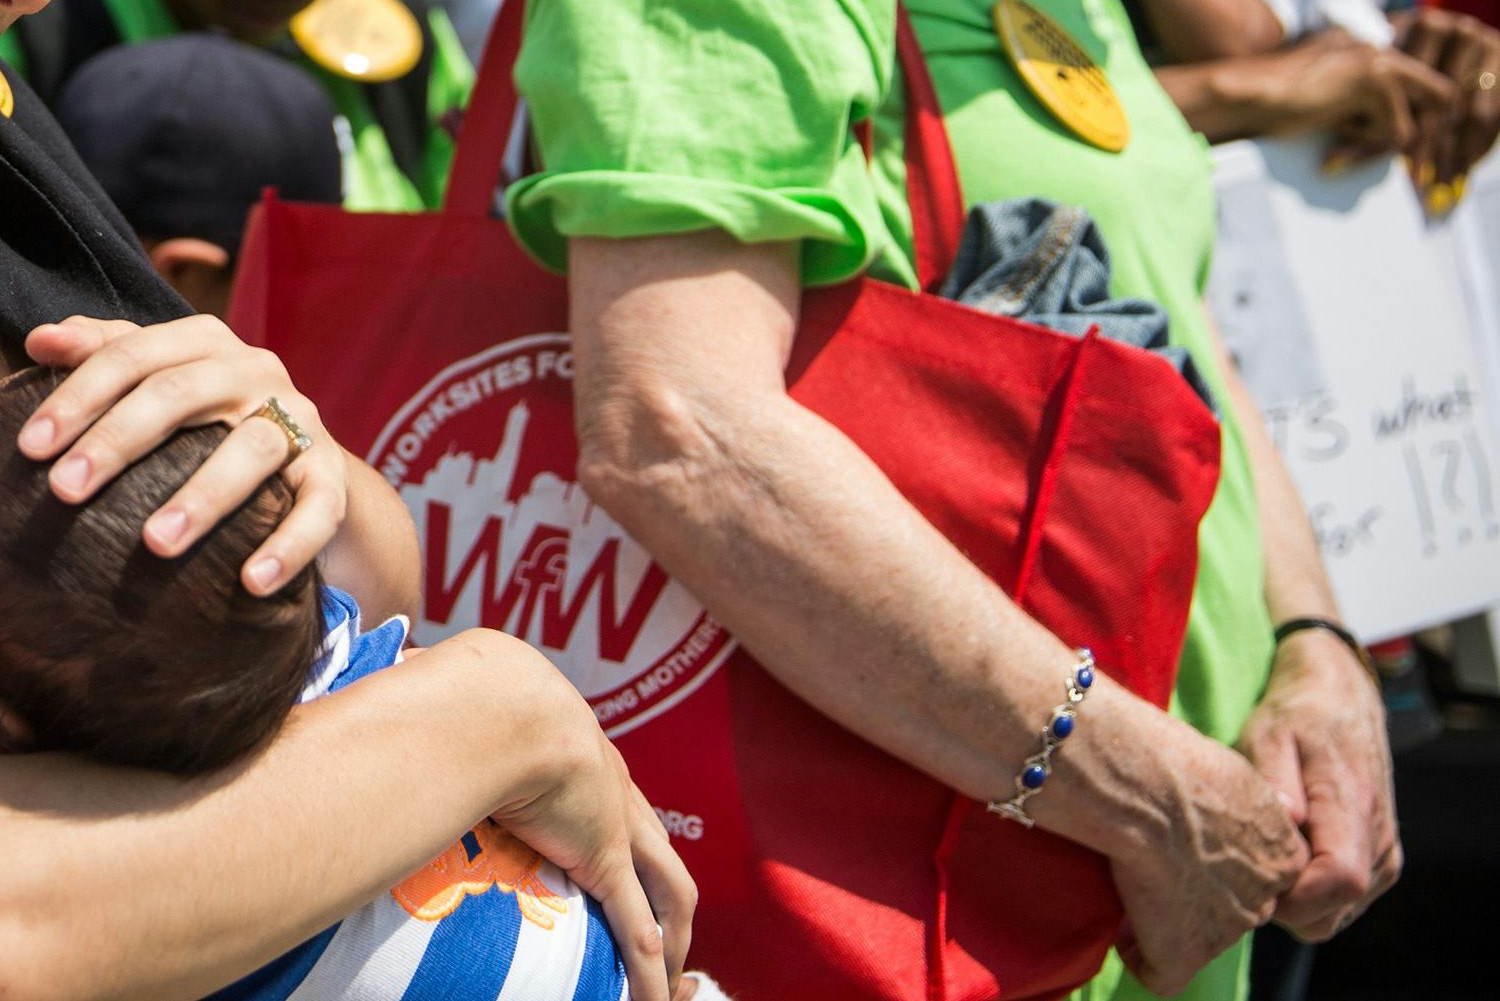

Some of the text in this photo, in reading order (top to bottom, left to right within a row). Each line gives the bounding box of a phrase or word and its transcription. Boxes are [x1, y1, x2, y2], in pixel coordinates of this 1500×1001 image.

[378, 351, 576, 488] WORKSITES FO
[1370, 374, 1480, 440] what
[635, 615, 722, 701] MOTHER
